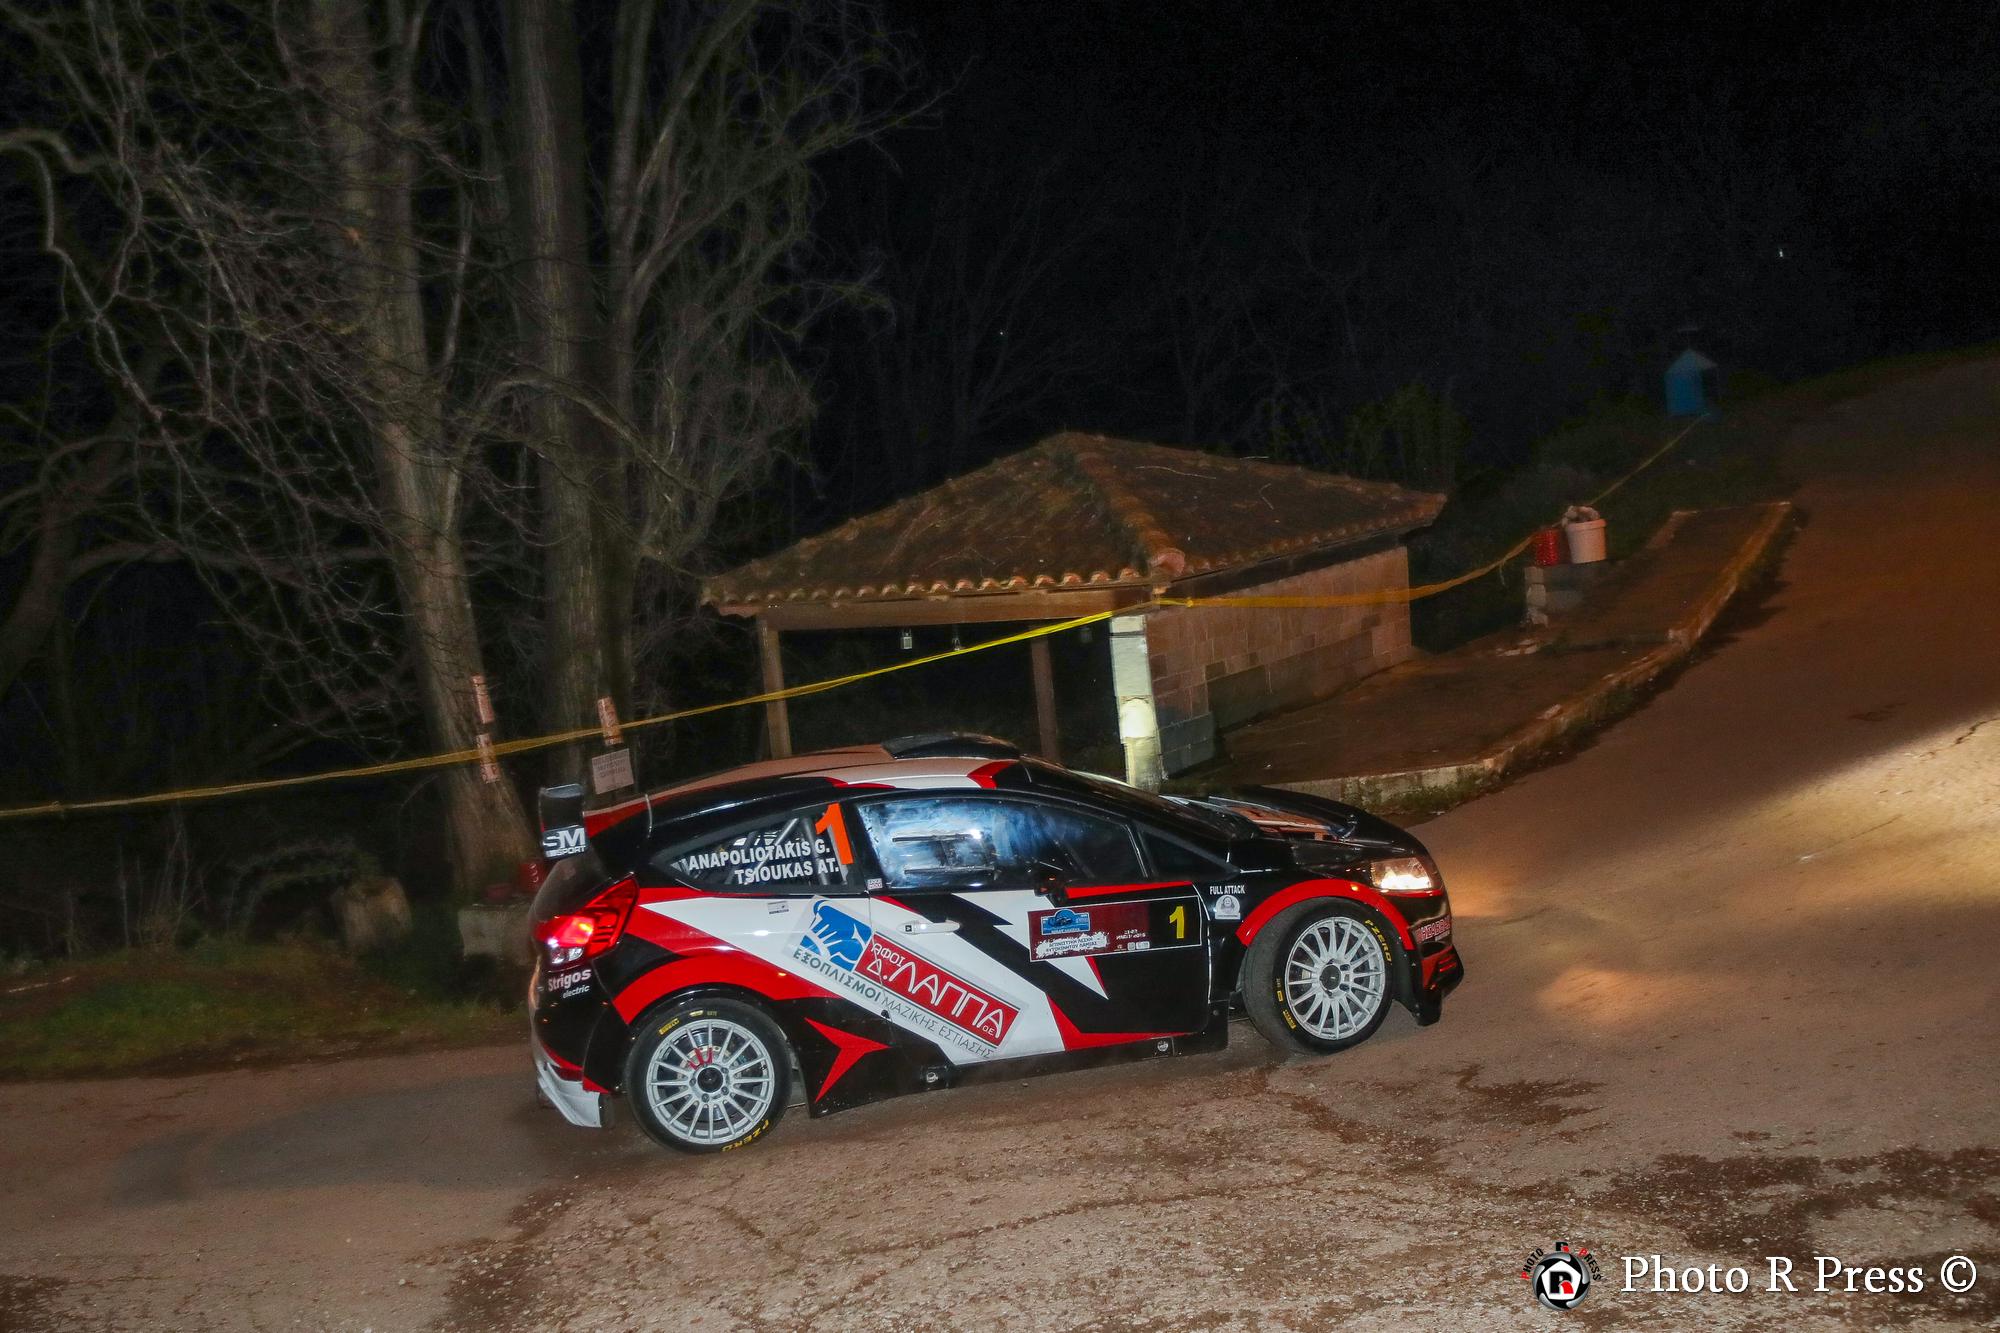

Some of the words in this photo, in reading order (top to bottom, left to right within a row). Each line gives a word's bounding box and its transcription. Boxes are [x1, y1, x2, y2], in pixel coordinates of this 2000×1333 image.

[815, 801, 854, 865] 1
[689, 841, 813, 871] ANAPOLIOTAKIS
[814, 838, 831, 854] G.
[734, 861, 814, 885] TSIOUKAS
[817, 857, 840, 874] AT.
[1210, 885, 1223, 895] FULL
[1224, 885, 1245, 895] ATTACK
[1169, 905, 1185, 939] 1
[548, 969, 591, 991] Strigos
[562, 984, 590, 998] electric
[793, 948, 882, 1001] ΕΞΟΠΛΙΣΜΟΙ
[881, 997, 938, 1032] ΜΑΖΙΚΗΣ
[938, 1026, 994, 1059] ΕΣΤΙΑΣΗΣ
